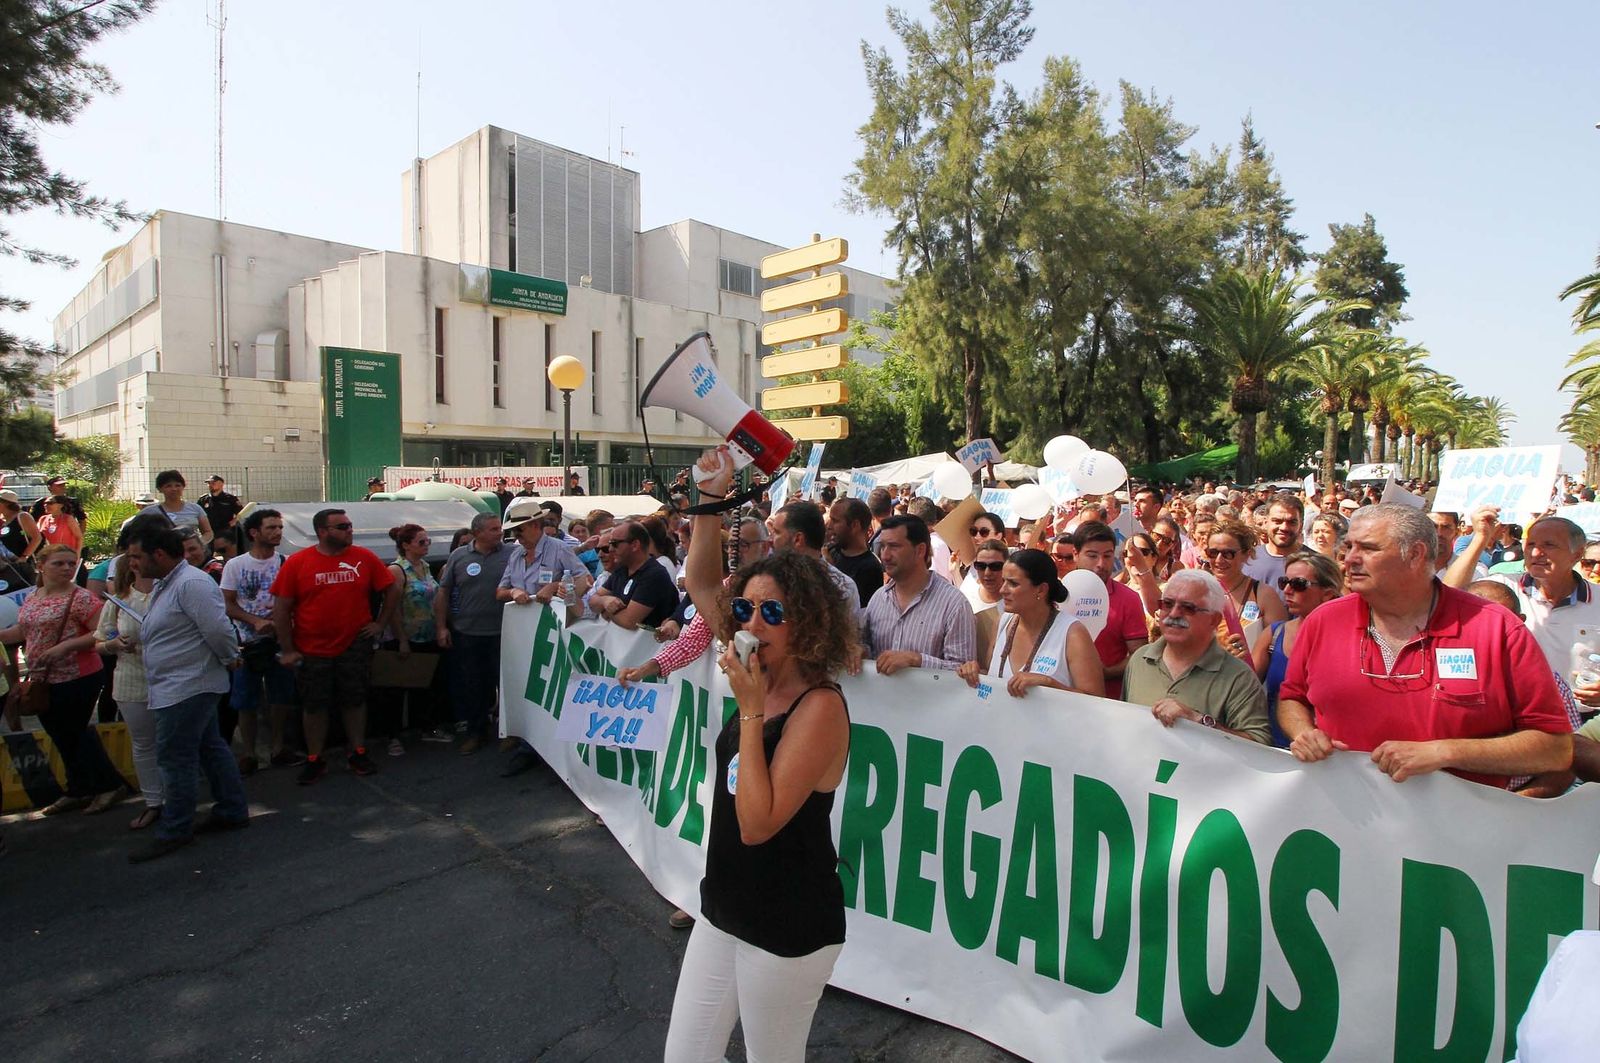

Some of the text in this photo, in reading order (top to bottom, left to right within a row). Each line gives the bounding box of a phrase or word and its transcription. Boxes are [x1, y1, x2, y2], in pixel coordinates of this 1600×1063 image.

[512, 288, 528, 297] JUNTA
[530, 290, 536, 298] DE
[335, 400, 344, 418] JUNTA
[1449, 452, 1542, 479] ¡¡AGUA
[464, 476, 482, 488] LAS
[484, 476, 522, 488] TIERAS
[536, 476, 563, 488] NUEST
[1463, 483, 1526, 508] YA!!
[1440, 654, 1474, 664] ¡¡AGUA
[1450, 664, 1470, 674] YA!!
[572, 680, 658, 714] ¡¡AGUA
[586, 711, 644, 744] YA!!
[655, 678, 709, 847] DE
[838, 723, 1341, 1063] REGADÍOS
